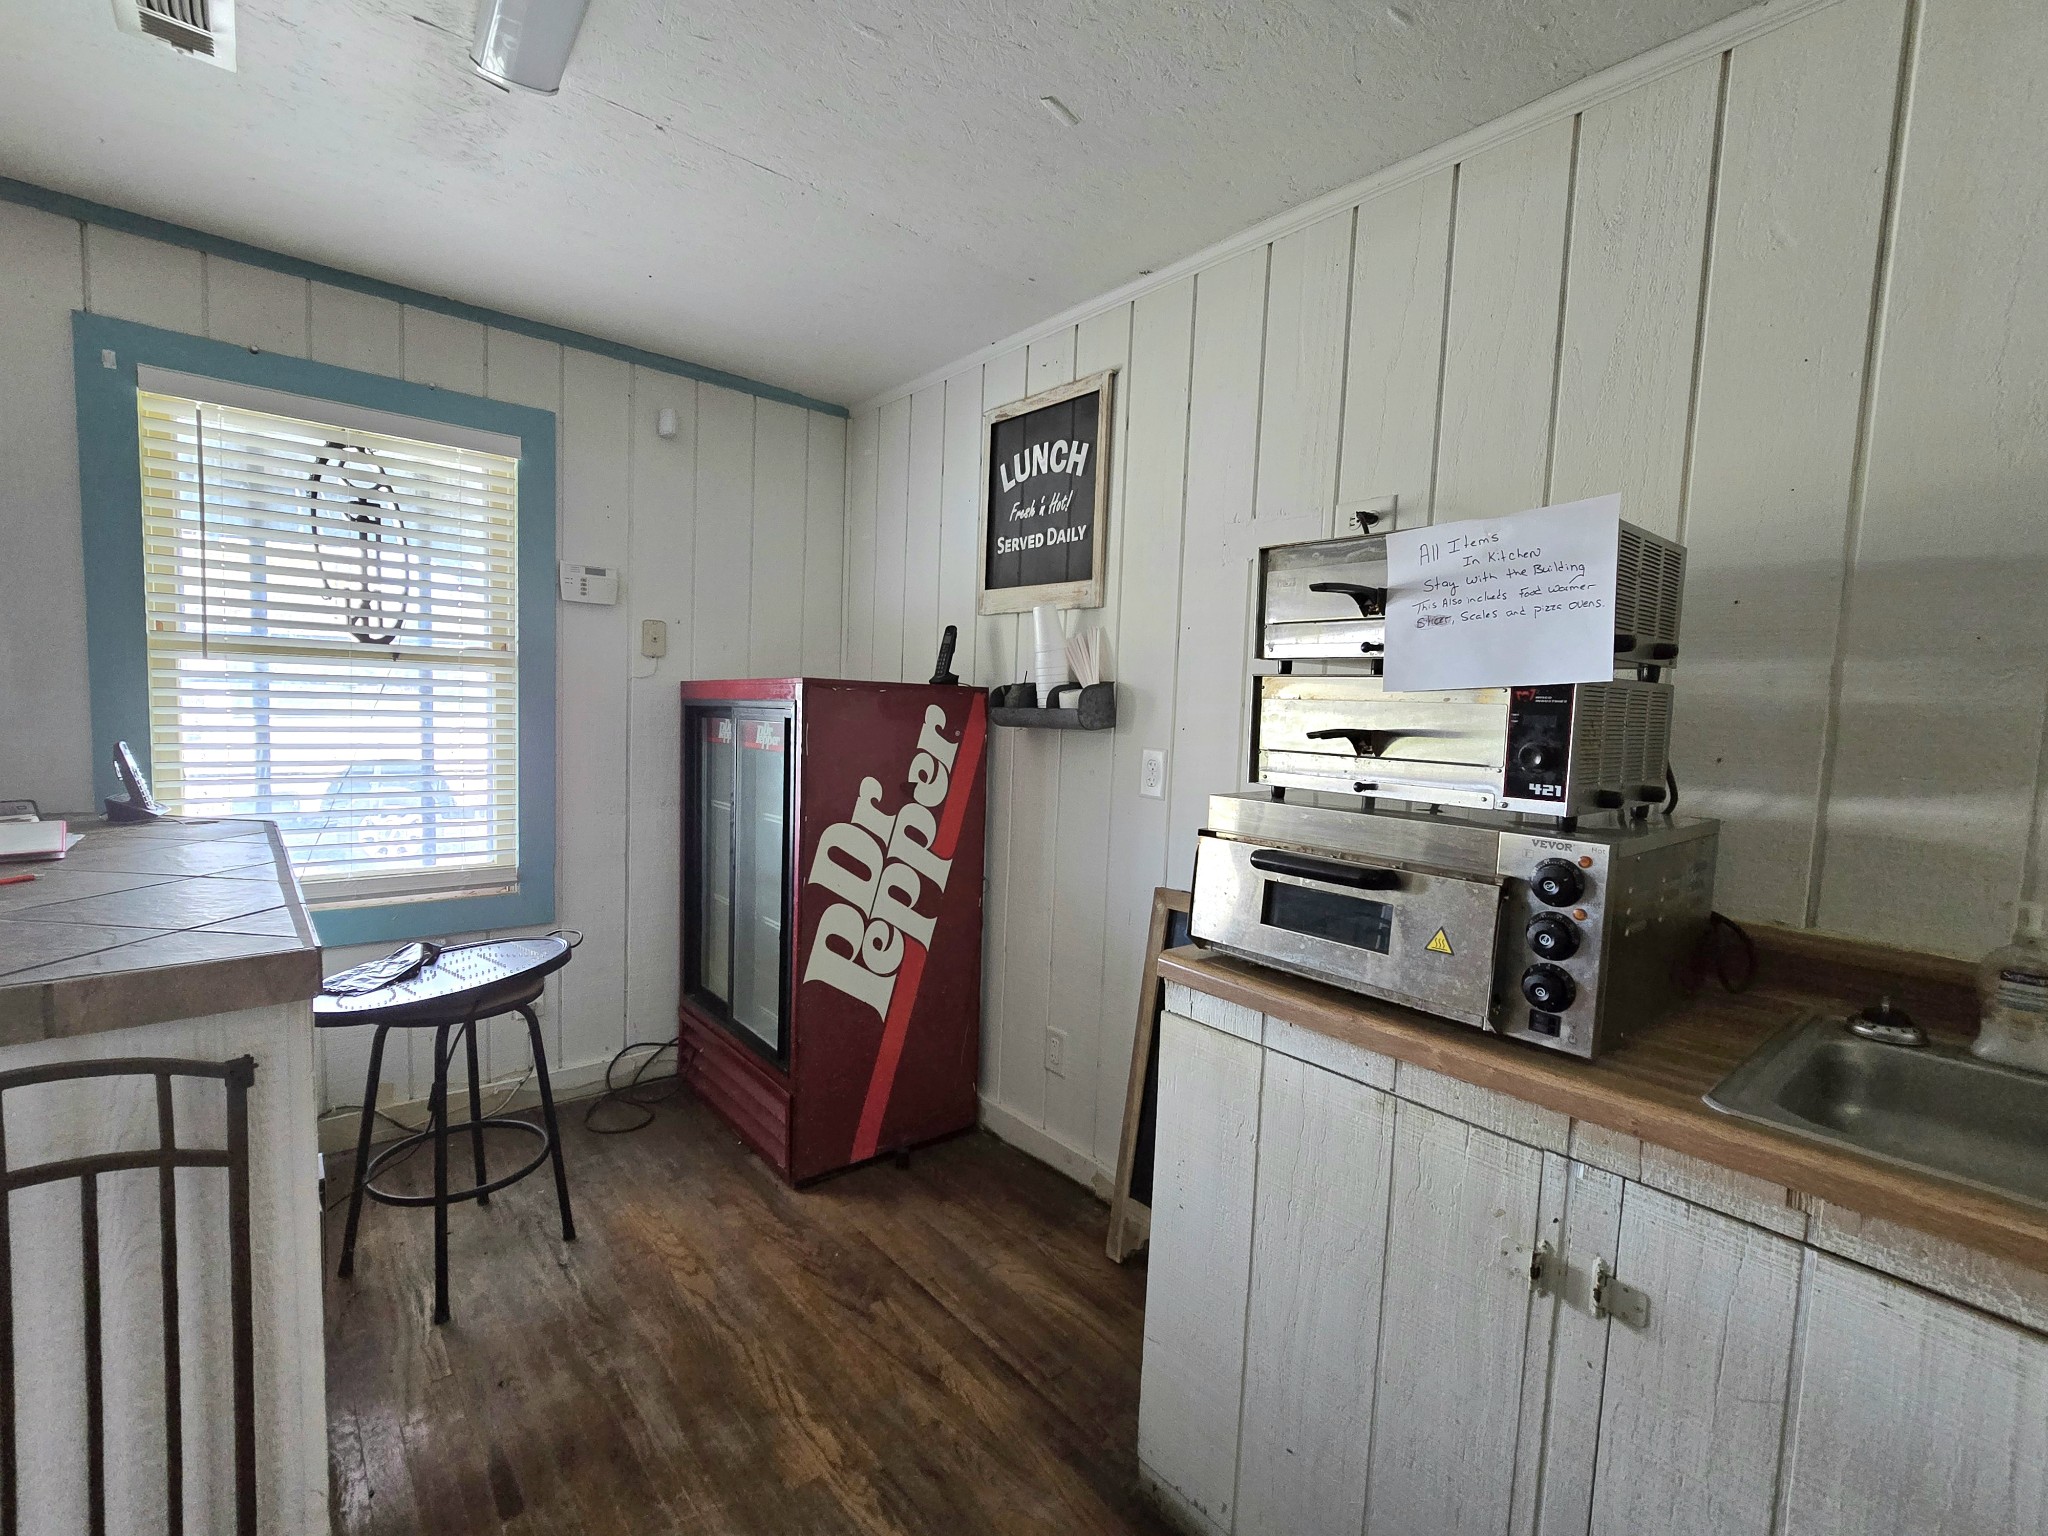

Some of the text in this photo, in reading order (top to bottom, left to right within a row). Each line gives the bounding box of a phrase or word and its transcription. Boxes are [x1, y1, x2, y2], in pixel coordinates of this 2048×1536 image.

[999, 439, 1090, 494] LUNCH
[1009, 500, 1036, 522] Fresh
[1048, 489, 1074, 515] Hot!
[1419, 533, 1499, 566] All Items
[1462, 547, 1541, 567] In Kitchen
[1423, 576, 1459, 596] Stay
[1506, 568, 1528, 579] the
[1533, 560, 1585, 584] Building
[1412, 599, 1437, 615] This
[1442, 597, 1462, 608] Also
[1460, 609, 1498, 622] Scales
[1506, 606, 1527, 617] and
[1528, 782, 1562, 797] 421
[808, 776, 896, 919] Dr
[1531, 839, 1573, 852] VEVOR
[1591, 847, 1606, 855] Hot
[802, 704, 959, 1023] Pepper
